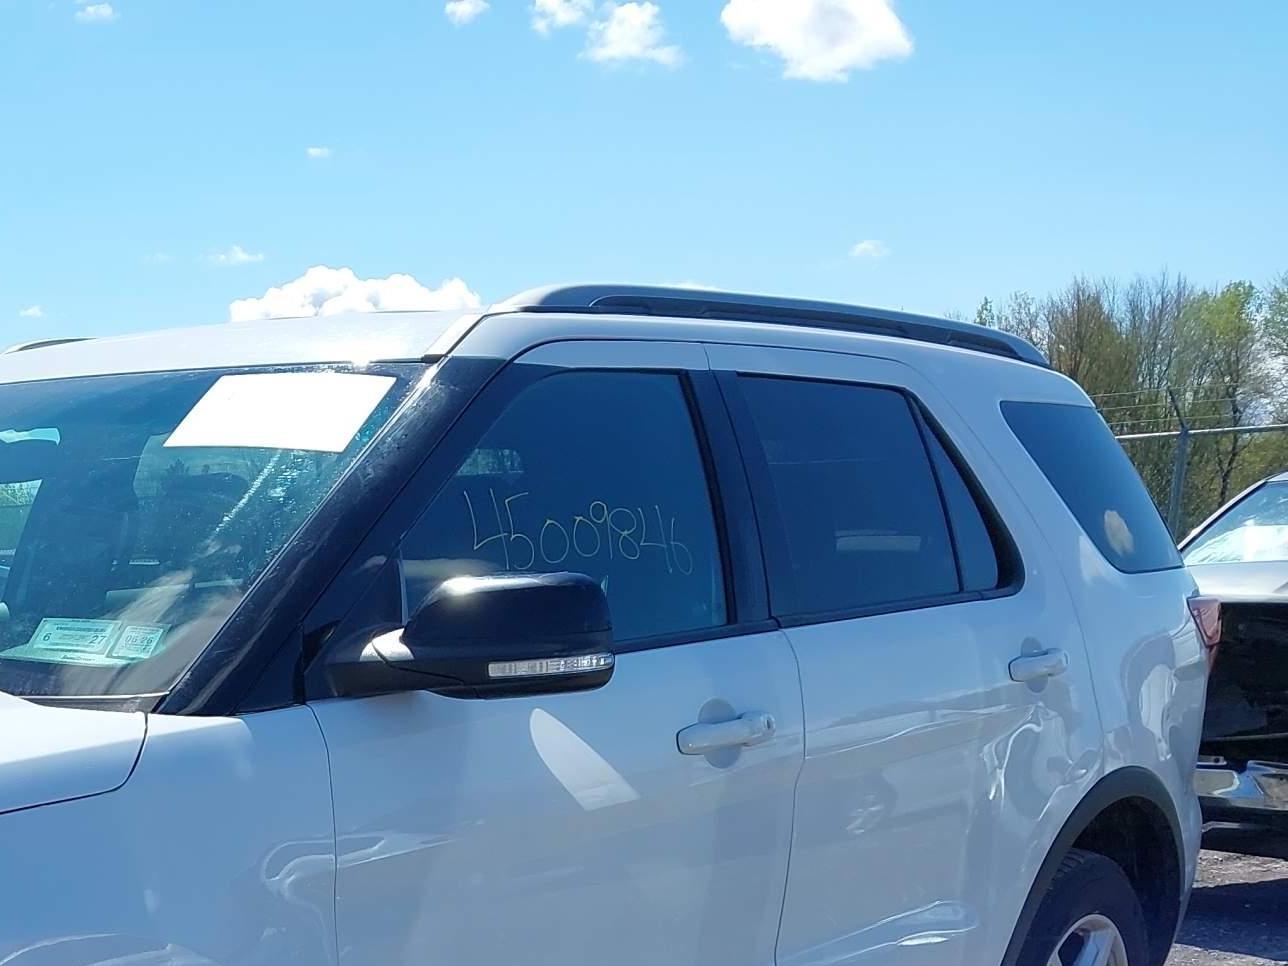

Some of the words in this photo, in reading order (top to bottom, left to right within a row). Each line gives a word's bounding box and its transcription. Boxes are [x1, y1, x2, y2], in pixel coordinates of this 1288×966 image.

[463, 487, 694, 576] 45009846
[42, 632, 52, 642] 6
[88, 634, 106, 645] 27
